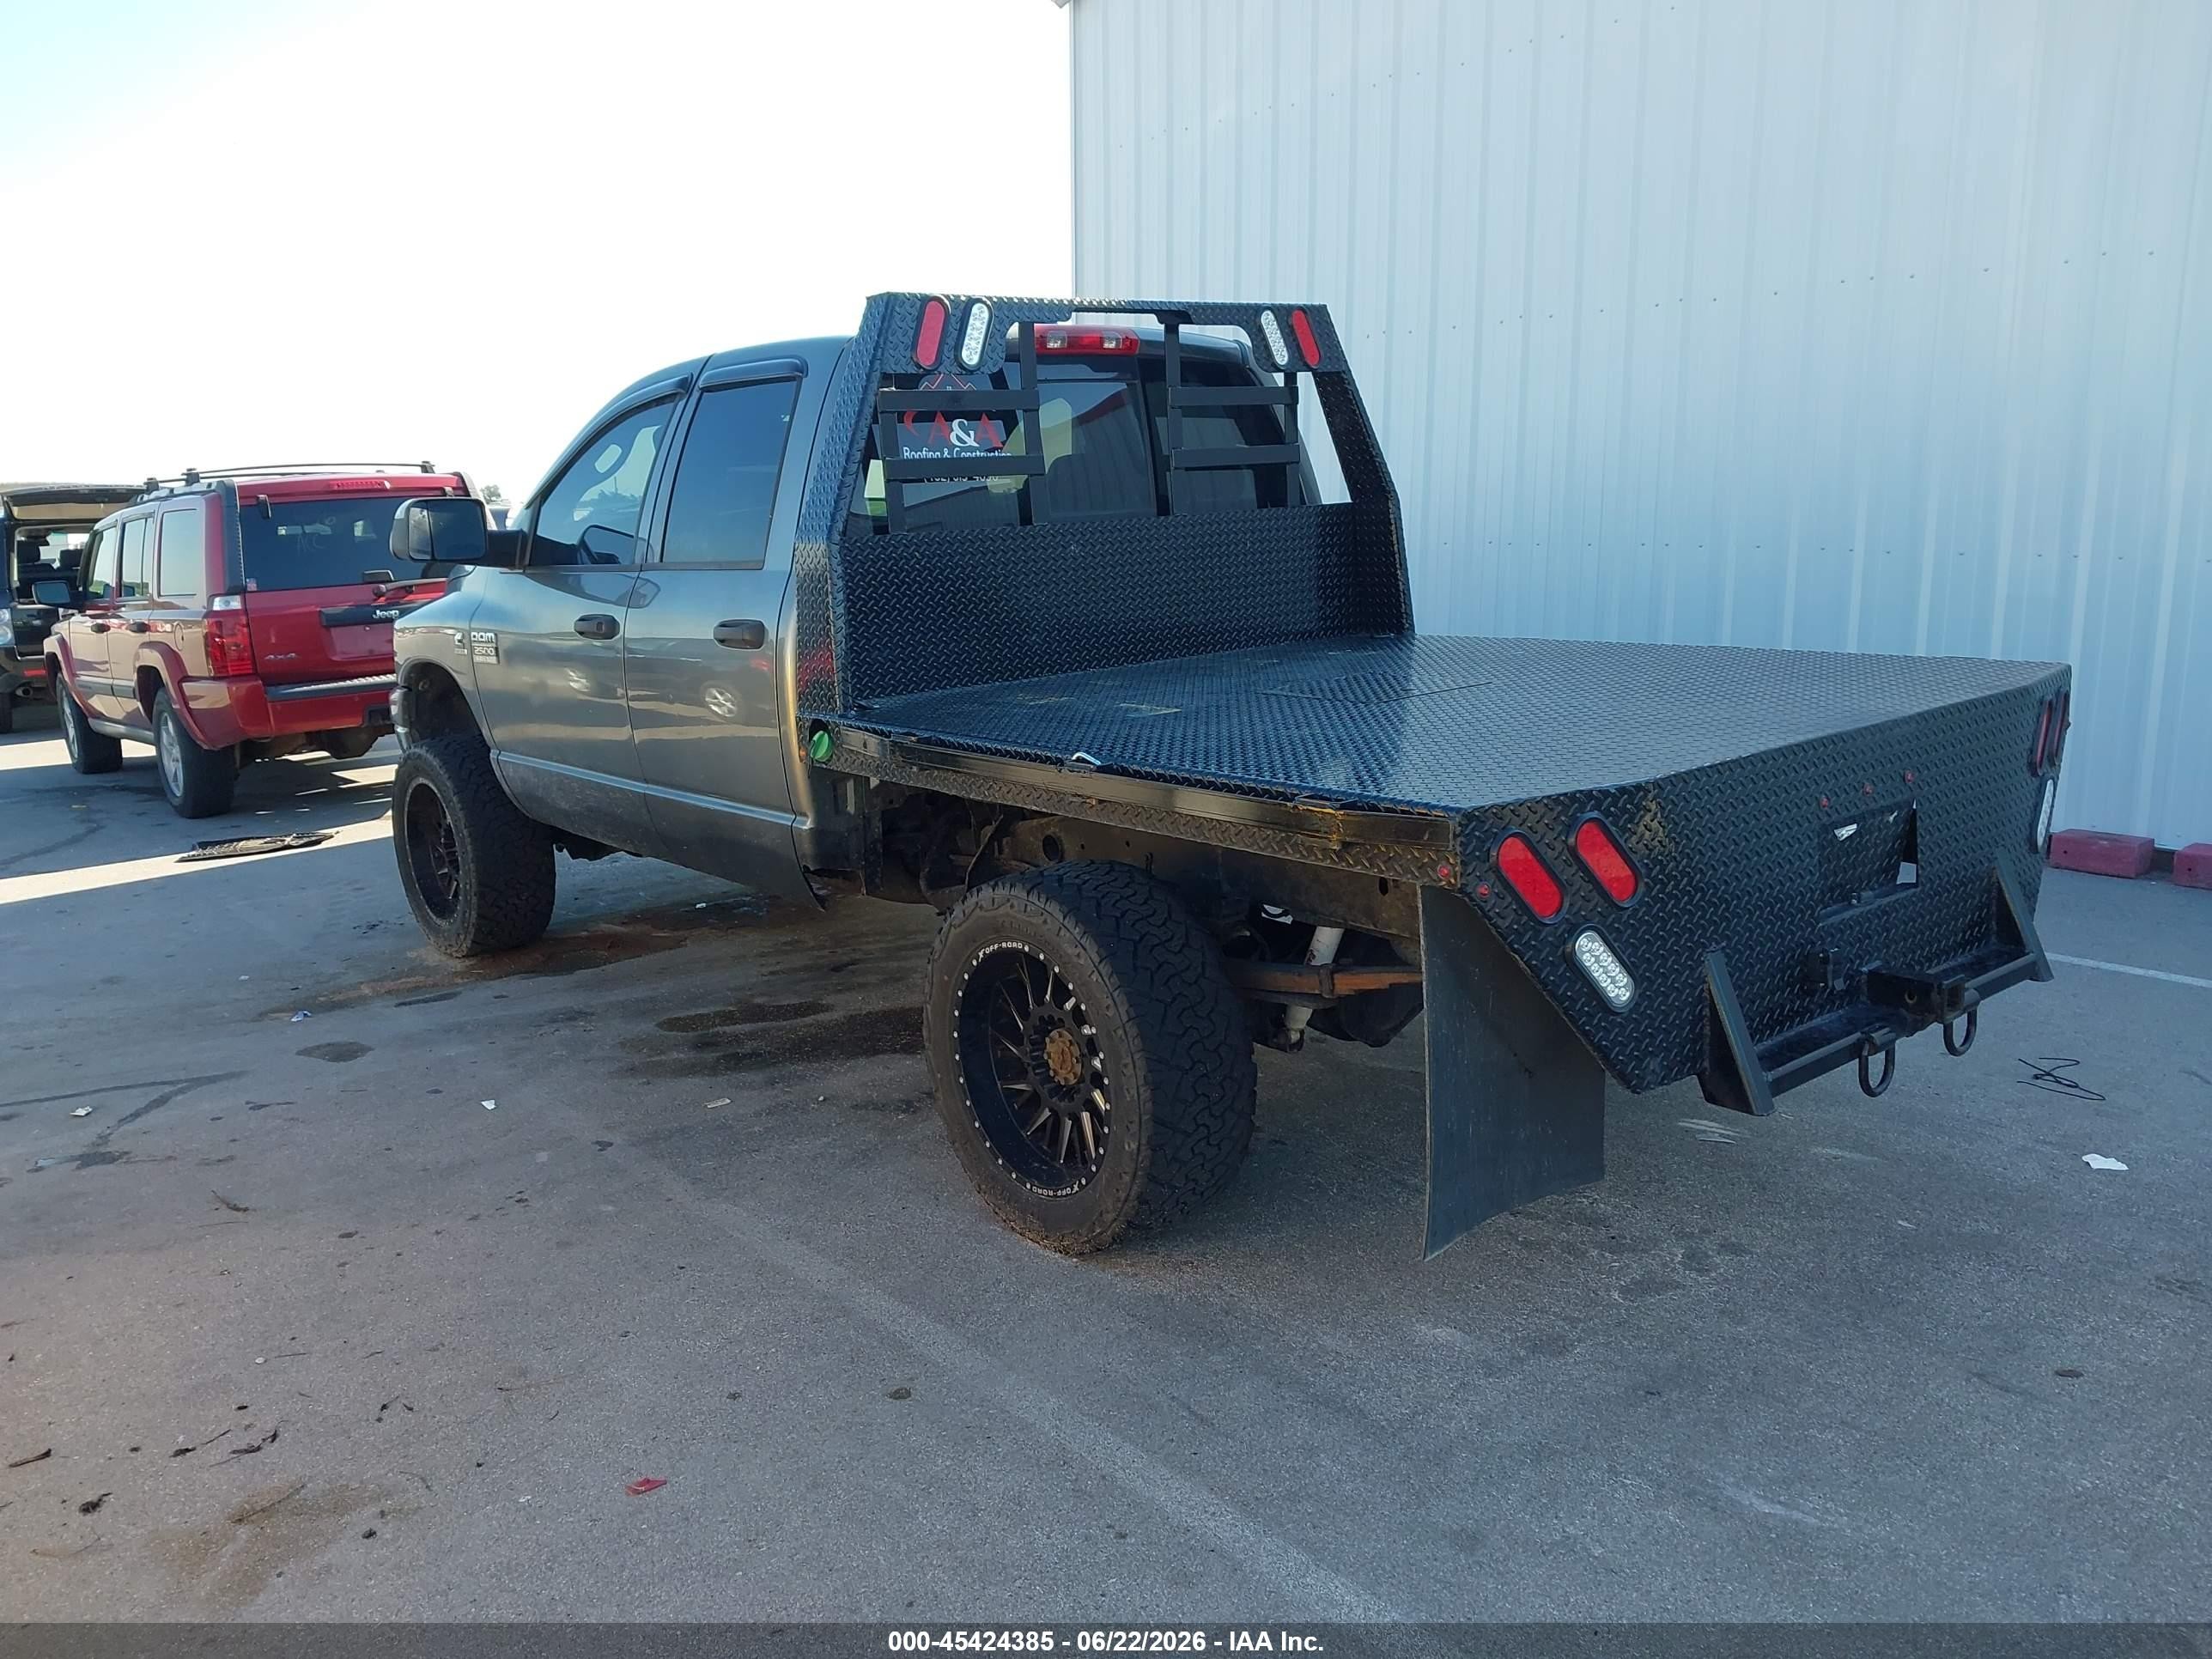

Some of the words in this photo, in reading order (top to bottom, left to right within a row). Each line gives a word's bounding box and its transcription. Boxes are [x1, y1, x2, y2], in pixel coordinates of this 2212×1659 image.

[943, 447, 951, 459] &
[372, 610, 399, 619] Jeep
[473, 646, 495, 656] 2500
